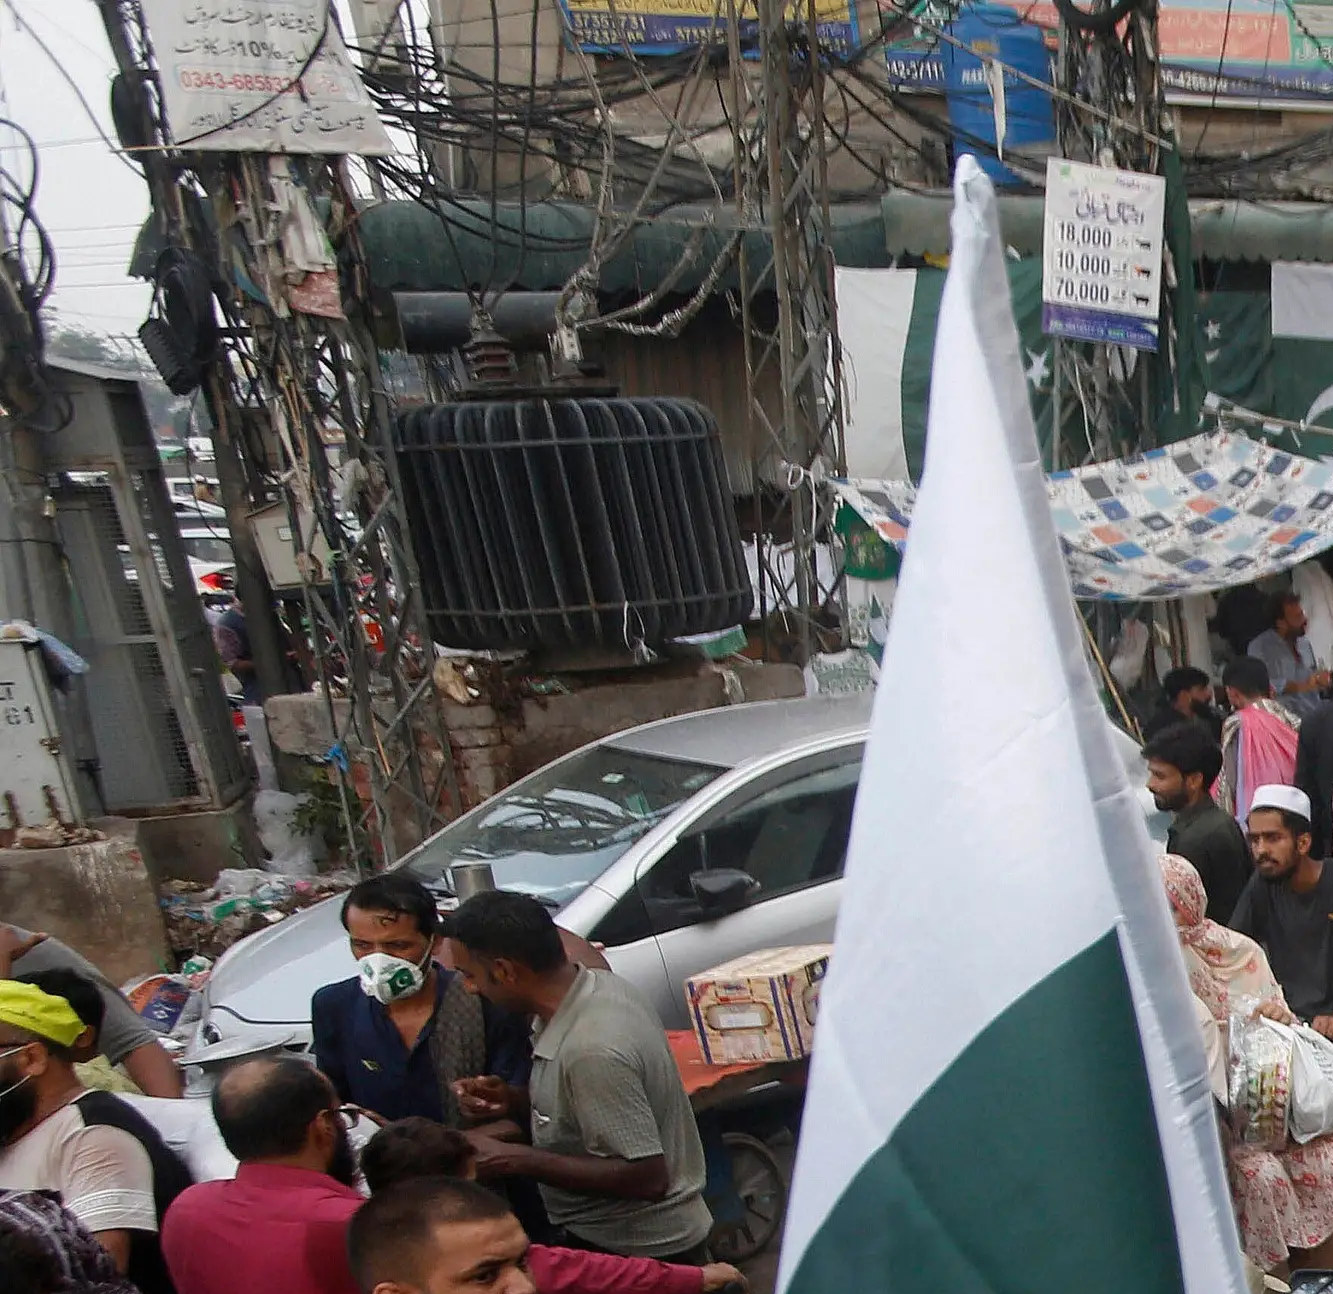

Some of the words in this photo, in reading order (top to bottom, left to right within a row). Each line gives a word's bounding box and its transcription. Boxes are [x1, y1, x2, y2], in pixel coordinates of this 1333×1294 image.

[1058, 221, 1112, 248] 18,000
[1057, 250, 1111, 277] 10,000
[1055, 278, 1110, 305] 70,000
